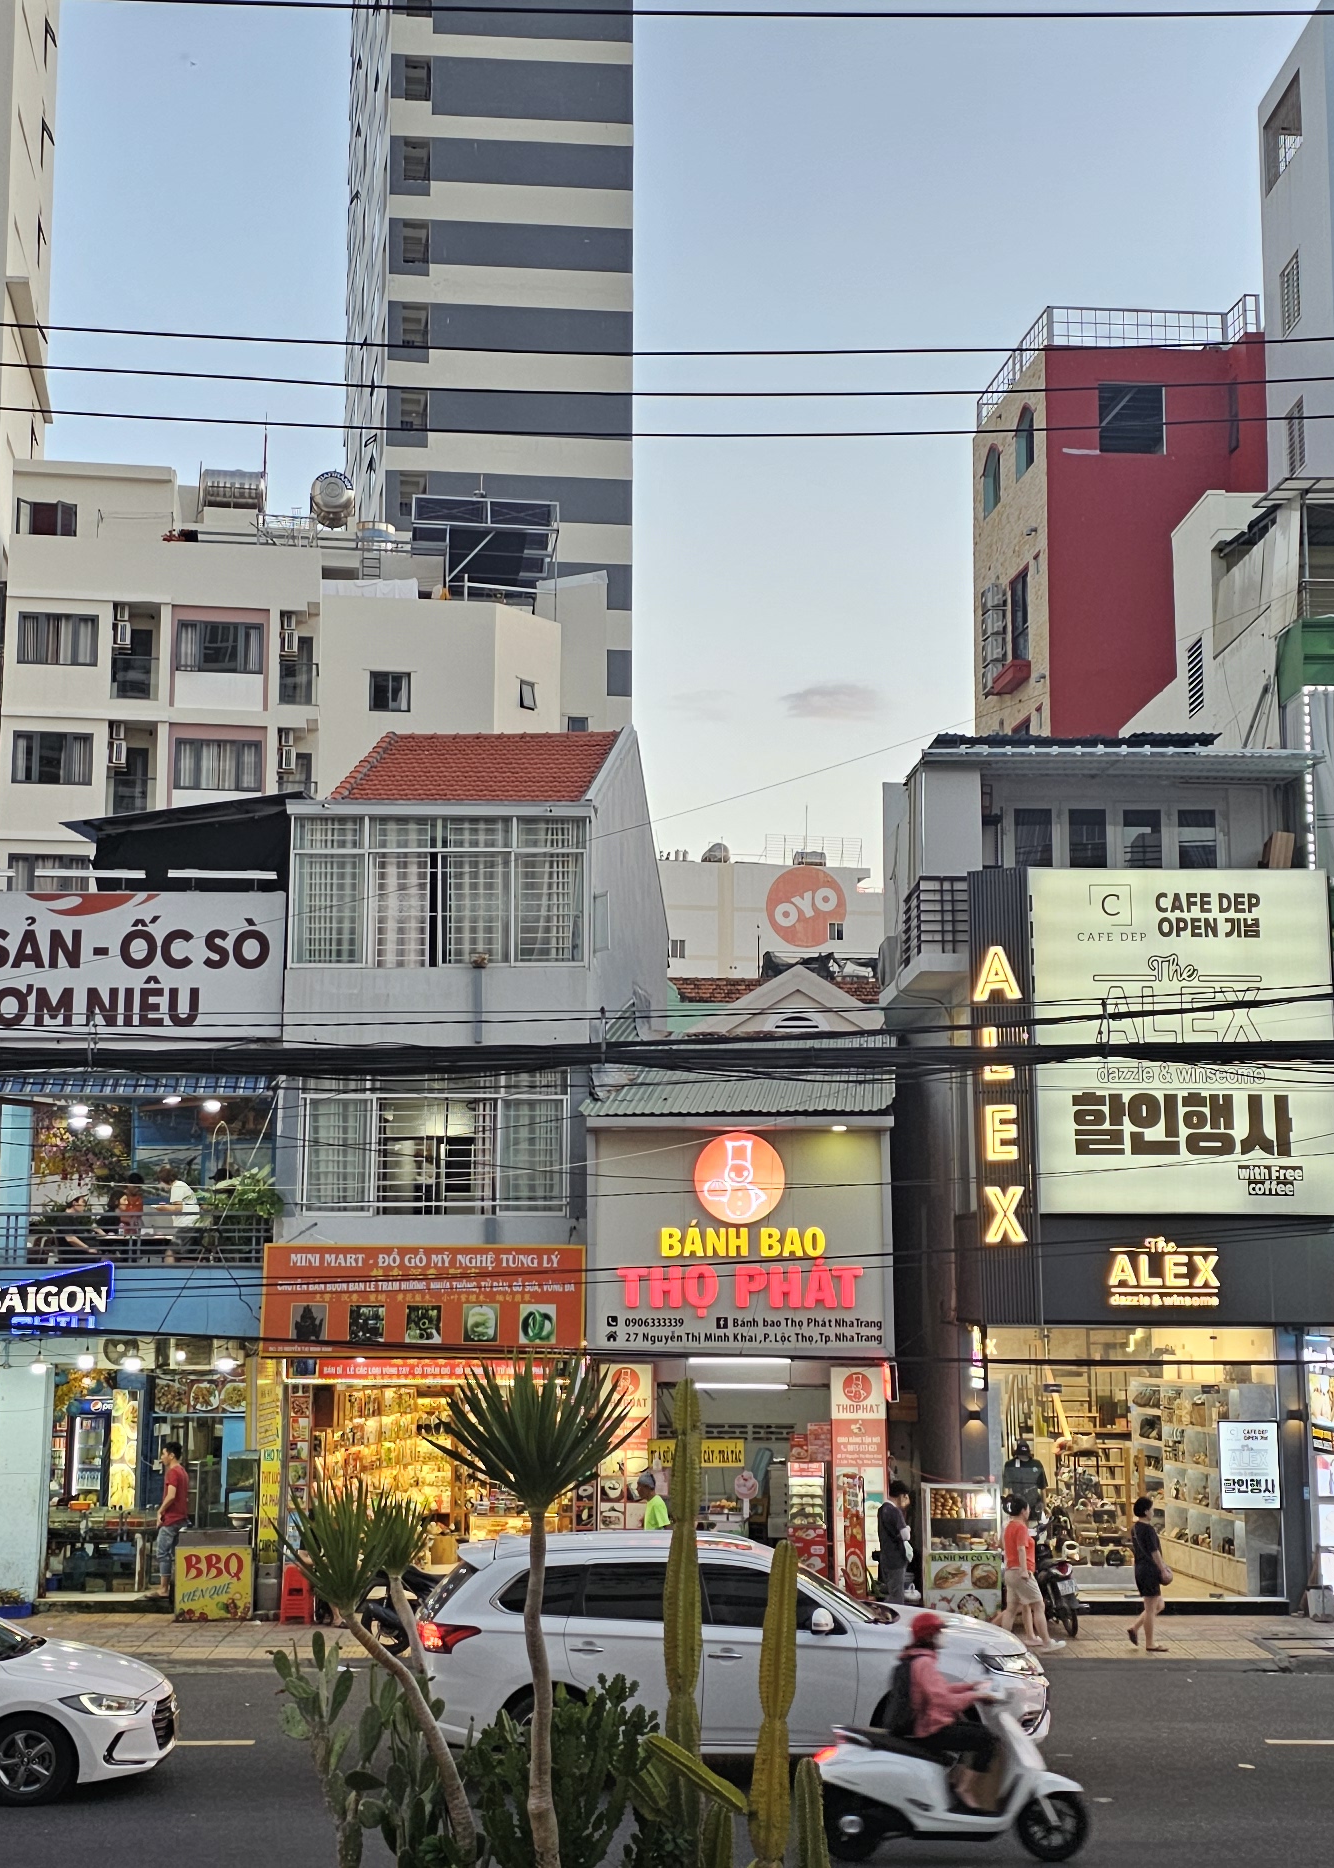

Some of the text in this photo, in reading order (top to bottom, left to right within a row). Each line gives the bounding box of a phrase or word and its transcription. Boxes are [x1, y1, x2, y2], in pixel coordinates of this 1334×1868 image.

[774, 887, 838, 927] OYO
[1101, 893, 1121, 917] C
[1155, 892, 1261, 913] CAFE DEP
[1077, 931, 1147, 942] CAFE DEP
[1157, 917, 1218, 938] OPEN
[119, 915, 199, 970] ỐC
[203, 917, 271, 970] SÒ
[1147, 953, 1199, 983] The
[86, 975, 200, 1028] NIÊU
[1096, 985, 1262, 1044] ALEX
[1097, 1062, 1173, 1084] dazzle &
[1072, 1091, 1292, 1157] 할인행사
[1238, 1166, 1303, 1181] with Free
[1249, 1181, 1294, 1196] coffee
[661, 1218, 826, 1257] BÁNH BAO
[290, 1248, 561, 1271] MINI MART ĐỒ GỖ MỸ NGHỆ TÙNG LÝ
[1109, 1253, 1220, 1287] ALEX
[617, 1257, 864, 1318] THỌ PHÁT
[1110, 1292, 1149, 1307] dazzle
[624, 1317, 684, 1327] 0906333339
[732, 1316, 833, 1331] Bánh bao Thọ Phát
[625, 1332, 639, 1343] 27
[642, 1330, 683, 1346] Nguyễn
[685, 1332, 701, 1345] Thị
[704, 1332, 730, 1343] Minh
[1229, 1451, 1269, 1468] ALEX
[1224, 1478, 1275, 1494] 할인행사
[184, 1552, 244, 1581] BBQ
[209, 1581, 234, 1599] QUE
